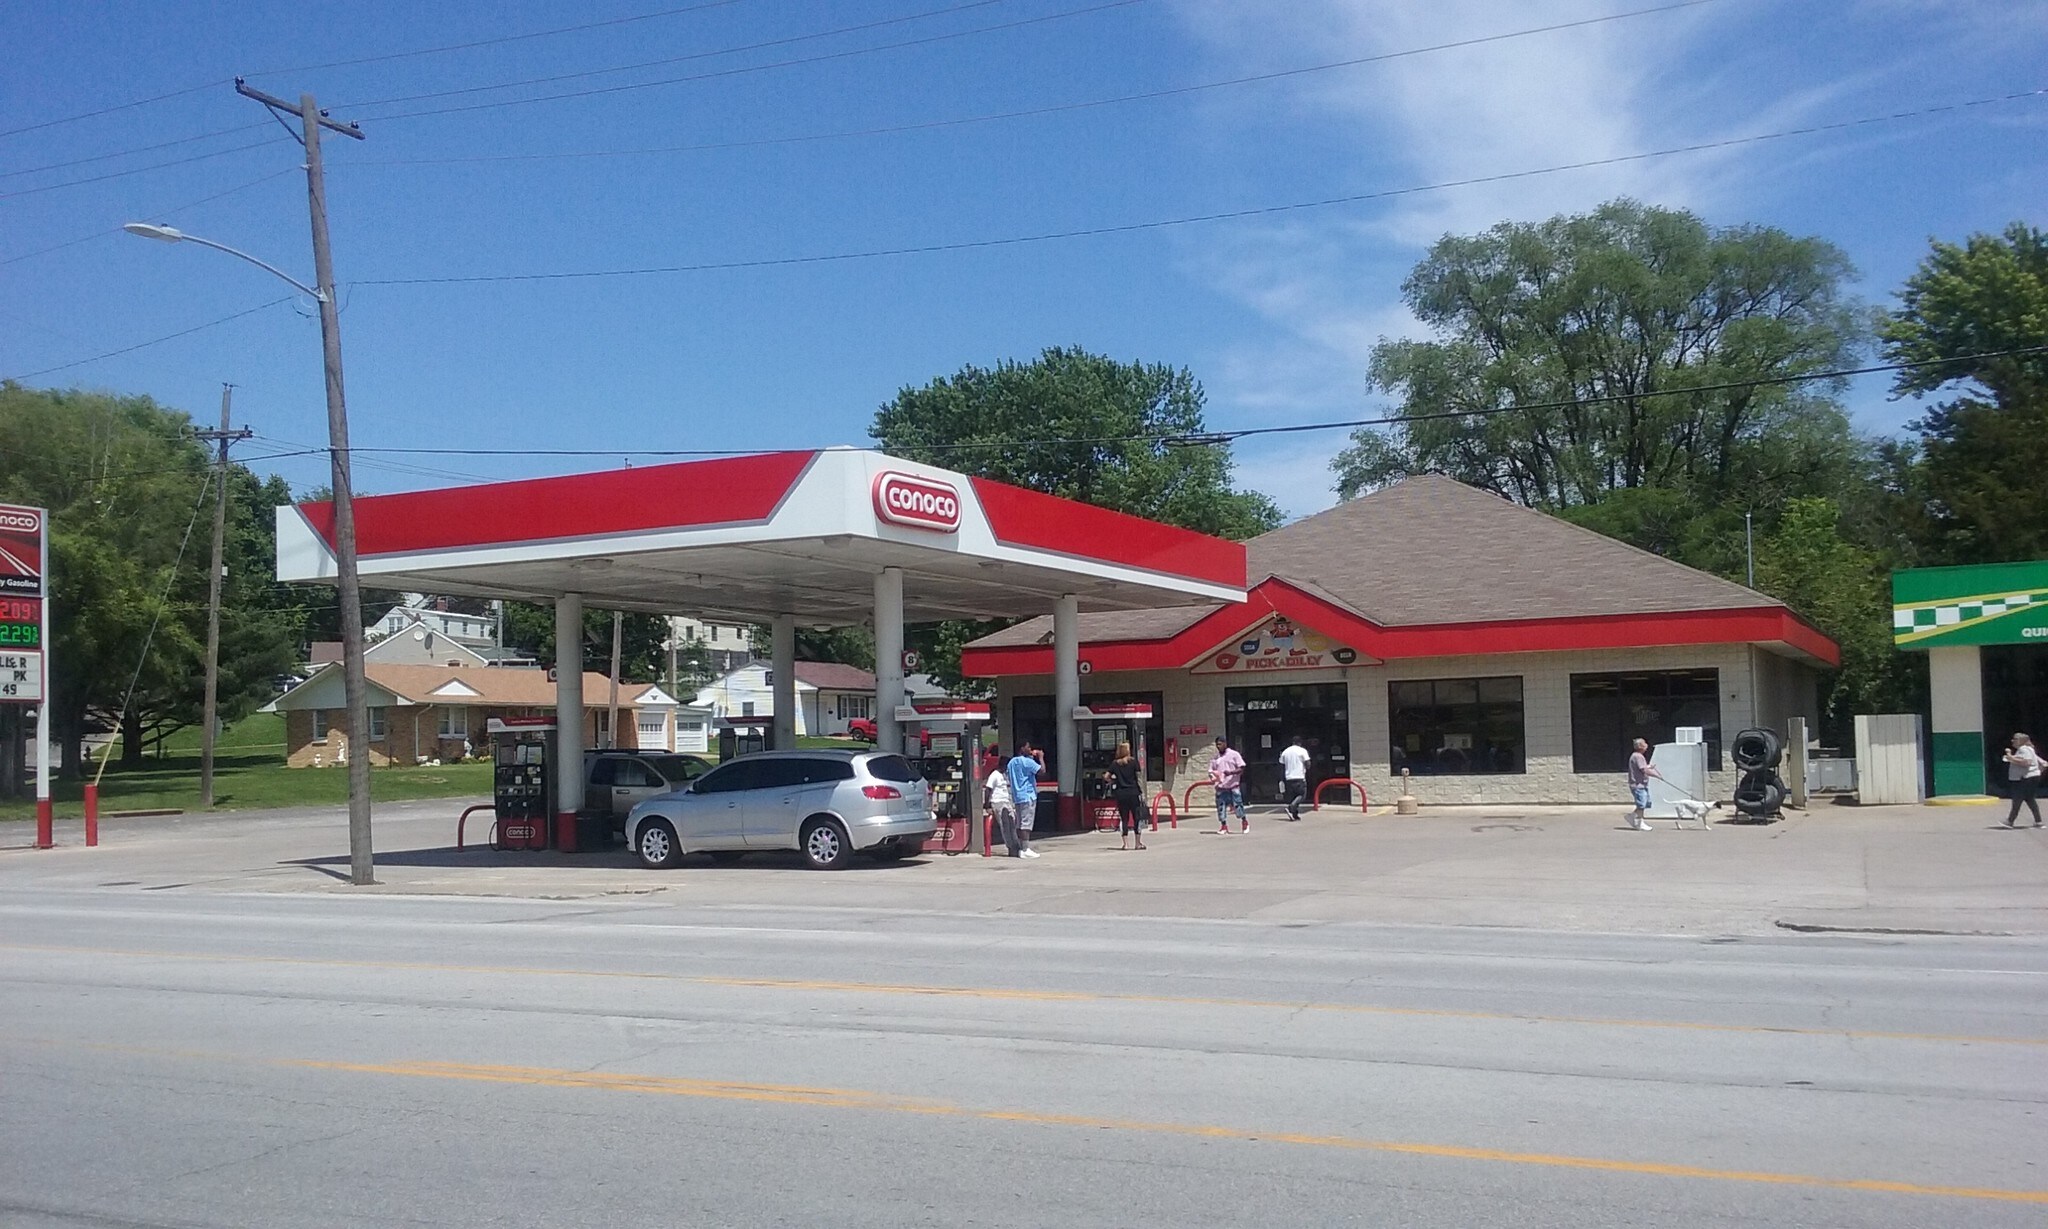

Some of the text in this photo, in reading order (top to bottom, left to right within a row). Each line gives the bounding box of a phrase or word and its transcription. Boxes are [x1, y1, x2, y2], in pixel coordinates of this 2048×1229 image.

[6, 578, 38, 588] Gasoline
[2022, 627, 2048, 637] QUI
[907, 655, 914, 664] 8
[13, 670, 27, 682] PK
[2, 683, 17, 695] 49
